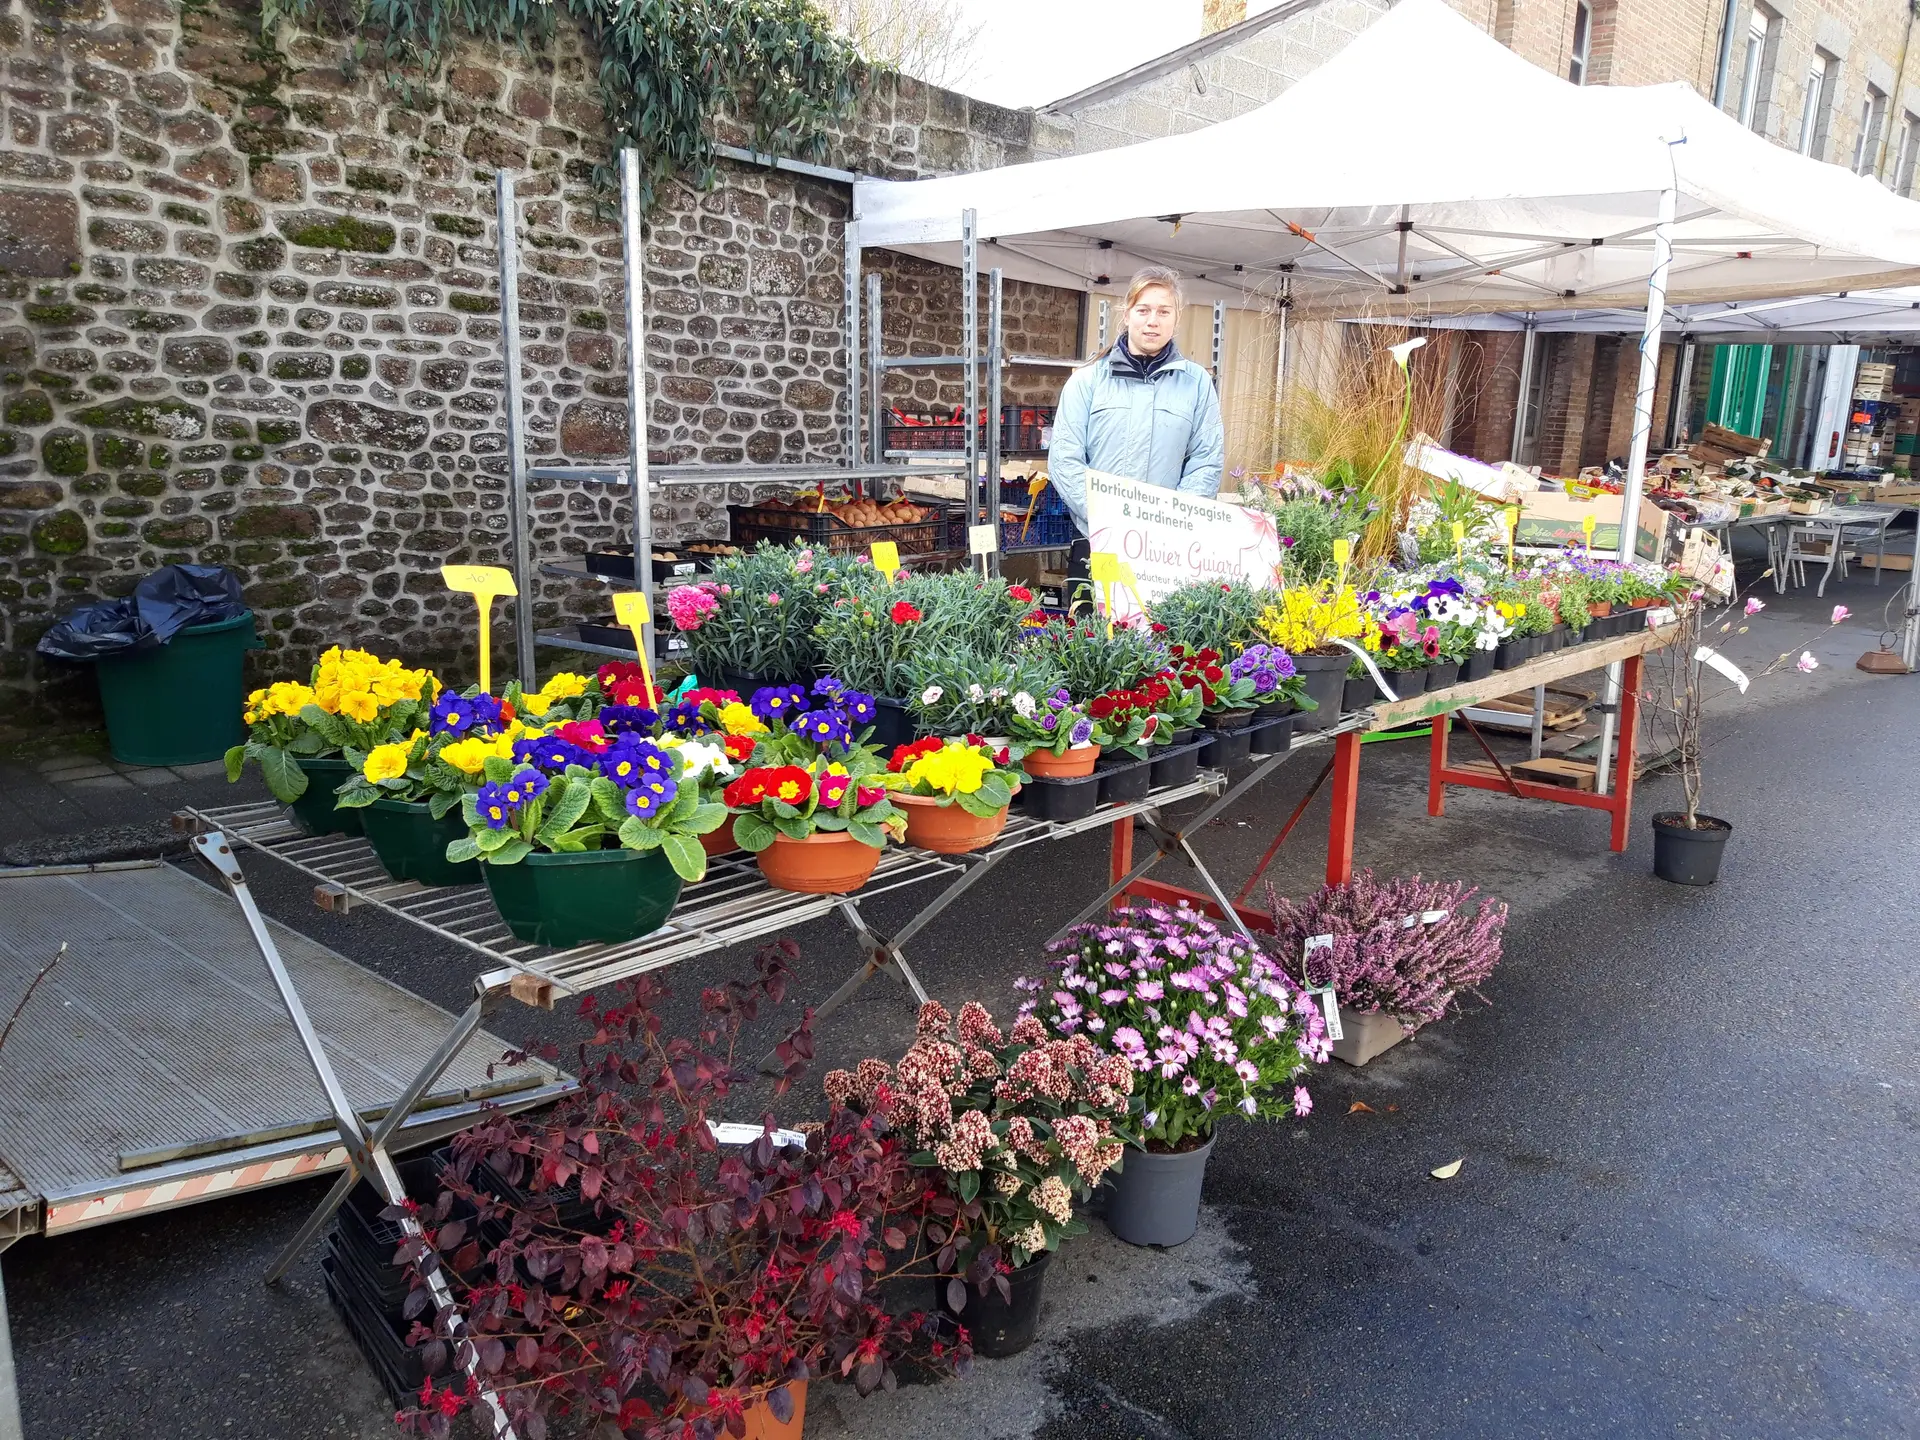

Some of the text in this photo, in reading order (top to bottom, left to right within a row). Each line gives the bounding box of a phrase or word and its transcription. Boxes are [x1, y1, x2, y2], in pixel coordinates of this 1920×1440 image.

[1091, 477, 1160, 505] Horticulteur
[1172, 497, 1232, 522] Paysagiste
[1123, 503, 1193, 531] & Jardinerie
[1124, 529, 1243, 578] Olivier Guiard
[1134, 569, 1170, 585] oducteur
